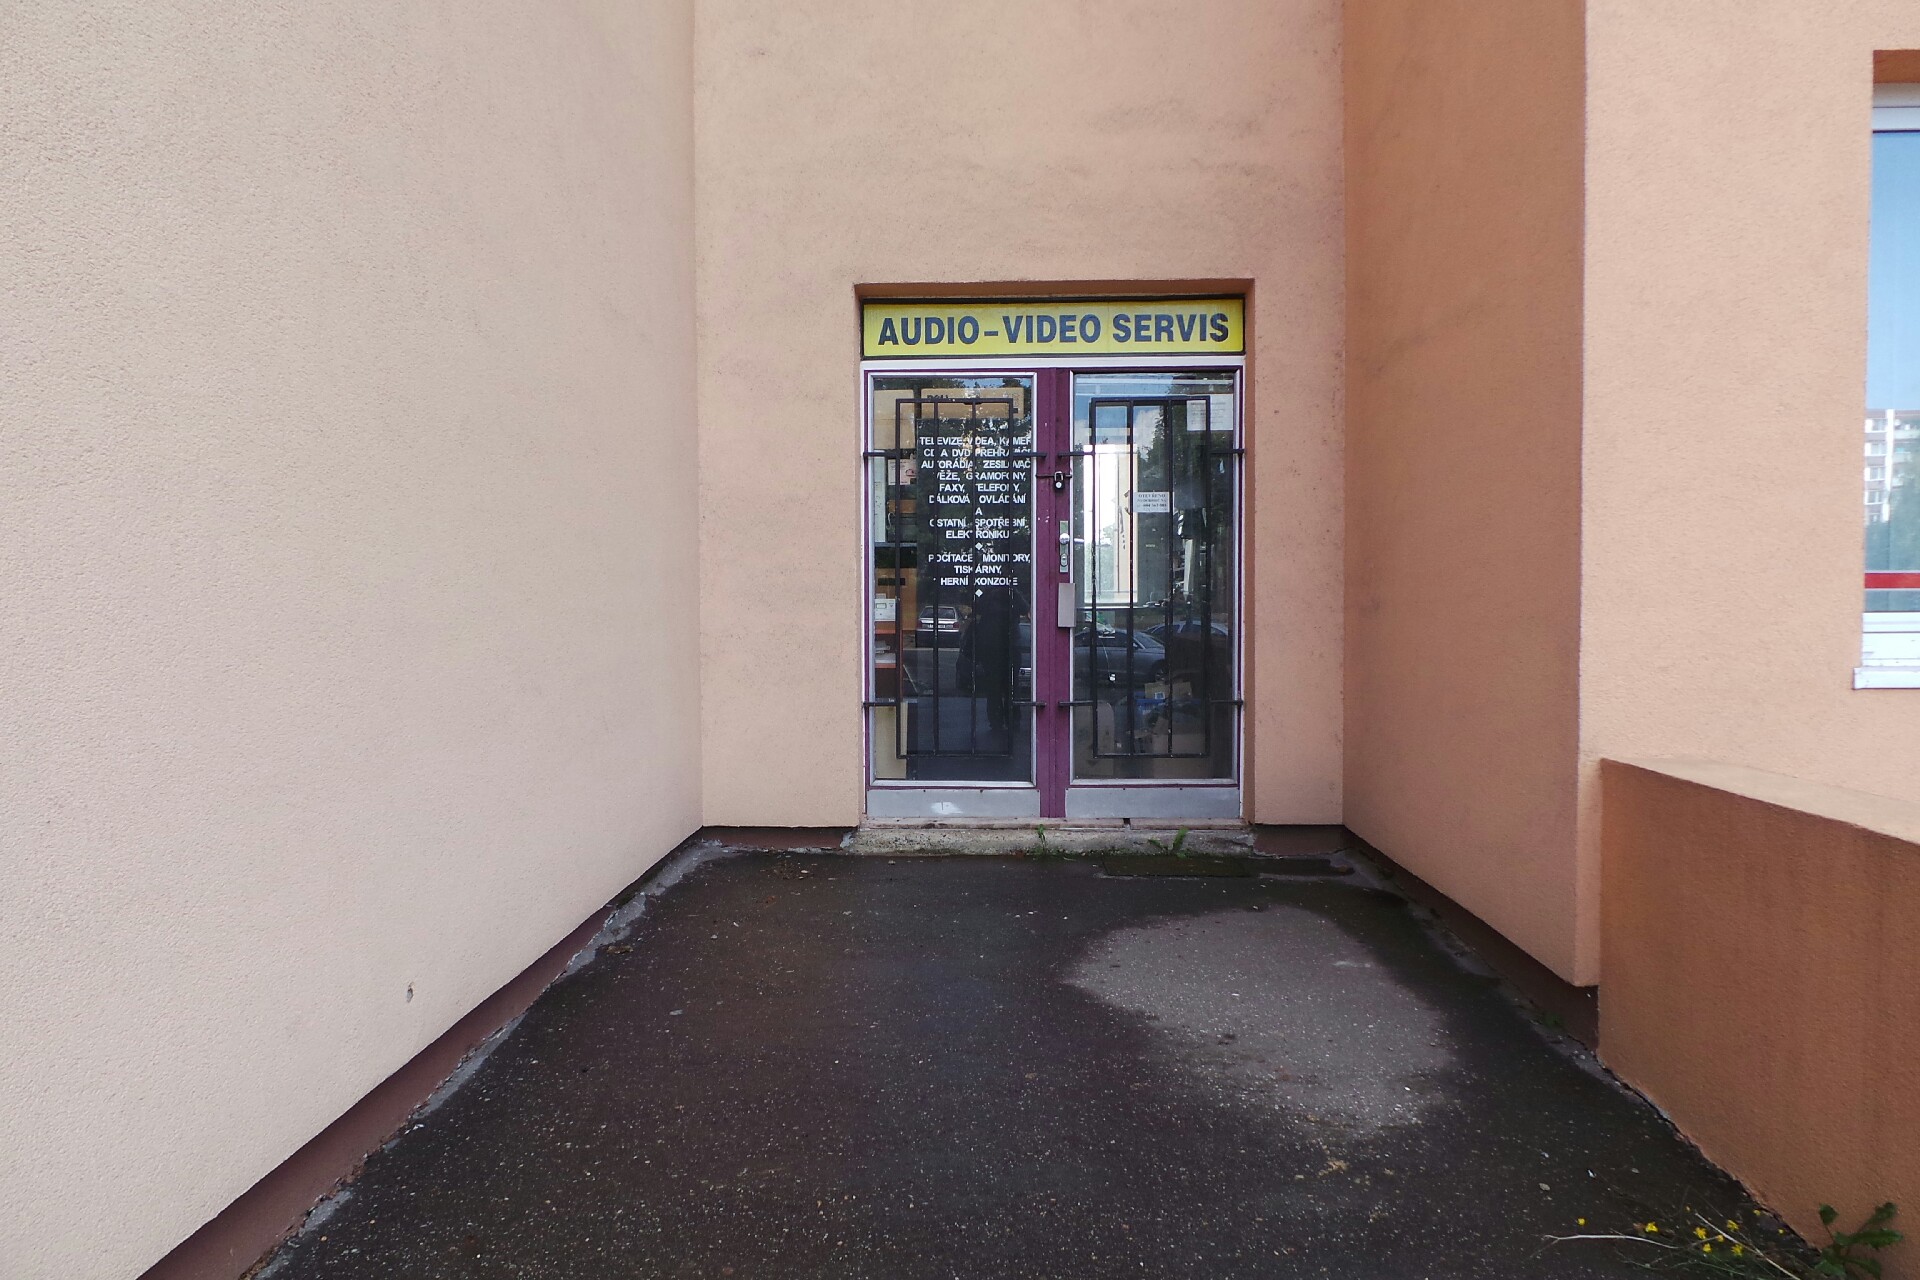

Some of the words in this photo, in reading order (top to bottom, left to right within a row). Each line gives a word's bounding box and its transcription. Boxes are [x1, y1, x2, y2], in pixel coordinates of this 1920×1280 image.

[1112, 313, 1229, 343] SERVIS
[940, 448, 949, 457] A
[951, 448, 972, 457] DVD
[939, 483, 966, 493] FAXY,
[928, 492, 971, 504] DÁLKOVÁ
[974, 506, 983, 516] A
[940, 574, 969, 586] HERNÍ
